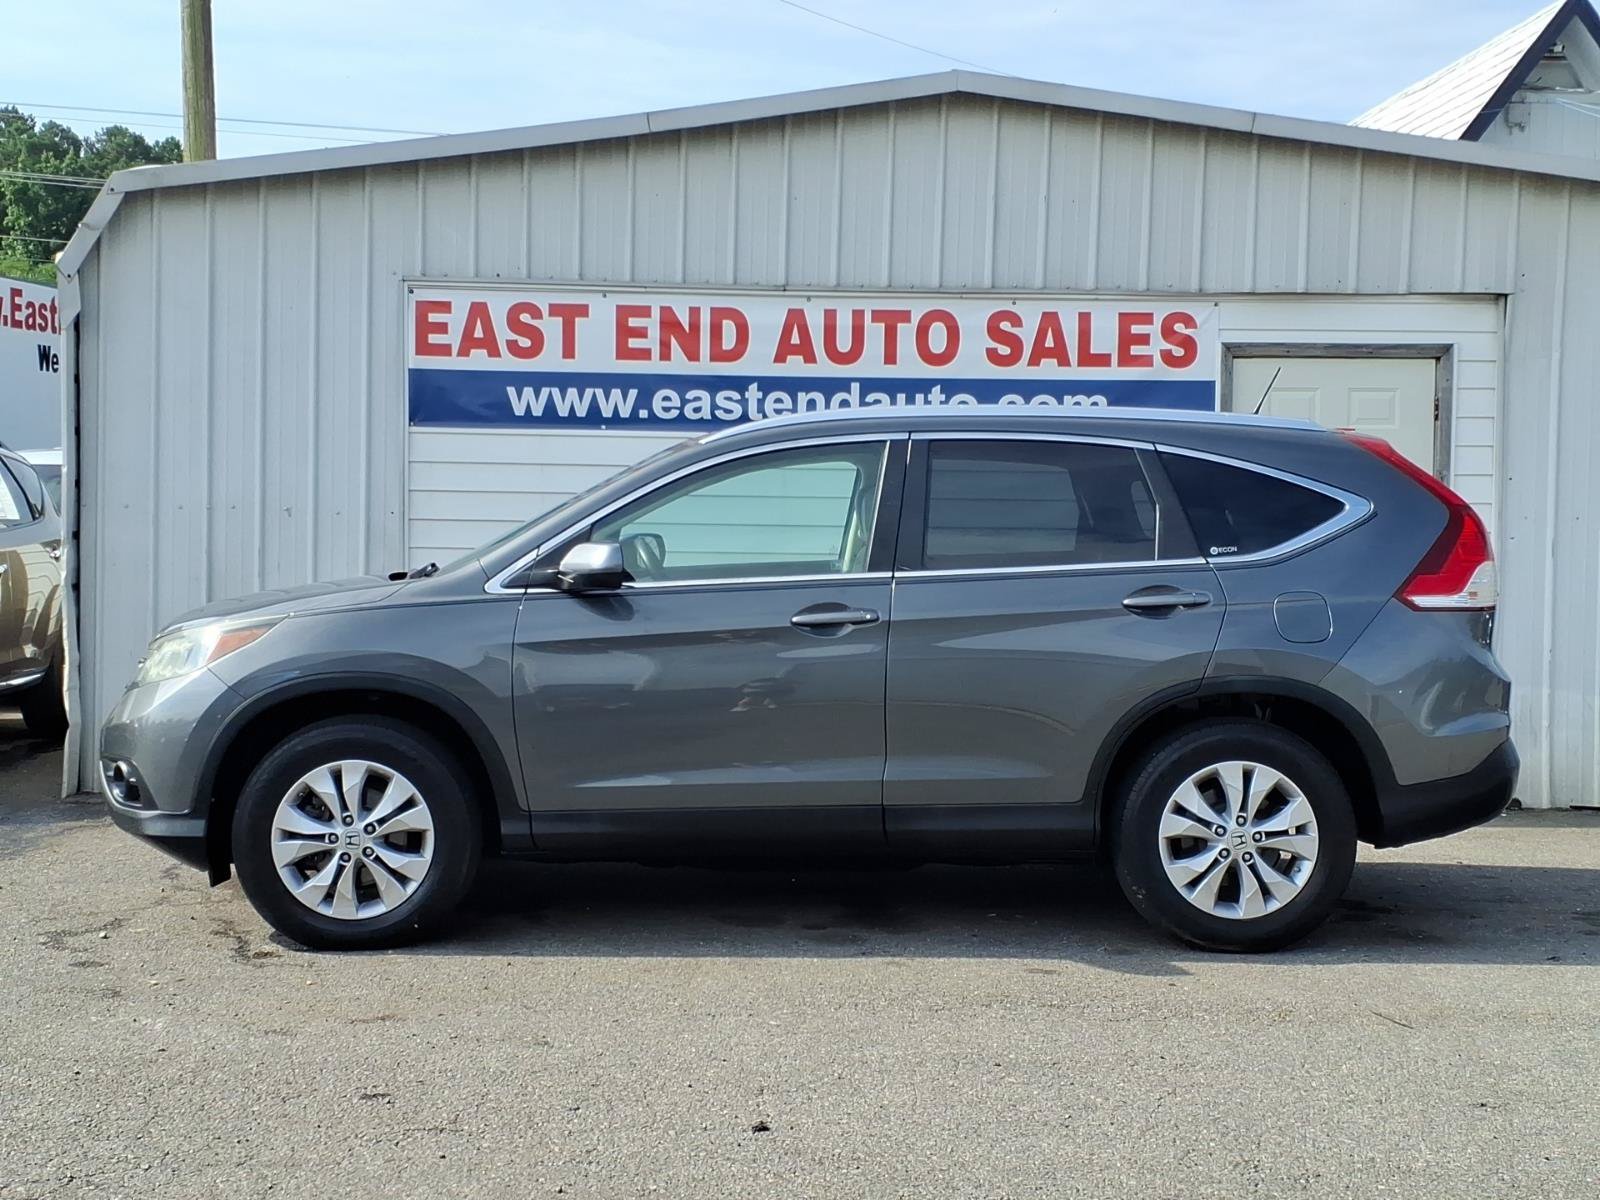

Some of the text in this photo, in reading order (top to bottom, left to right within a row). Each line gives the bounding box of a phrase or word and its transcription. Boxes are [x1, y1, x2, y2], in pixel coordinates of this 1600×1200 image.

[0, 287, 61, 335] .East
[415, 301, 1198, 369] EAST END AUTO SALES
[37, 344, 59, 373] We
[506, 381, 1108, 422] www.eastendt
